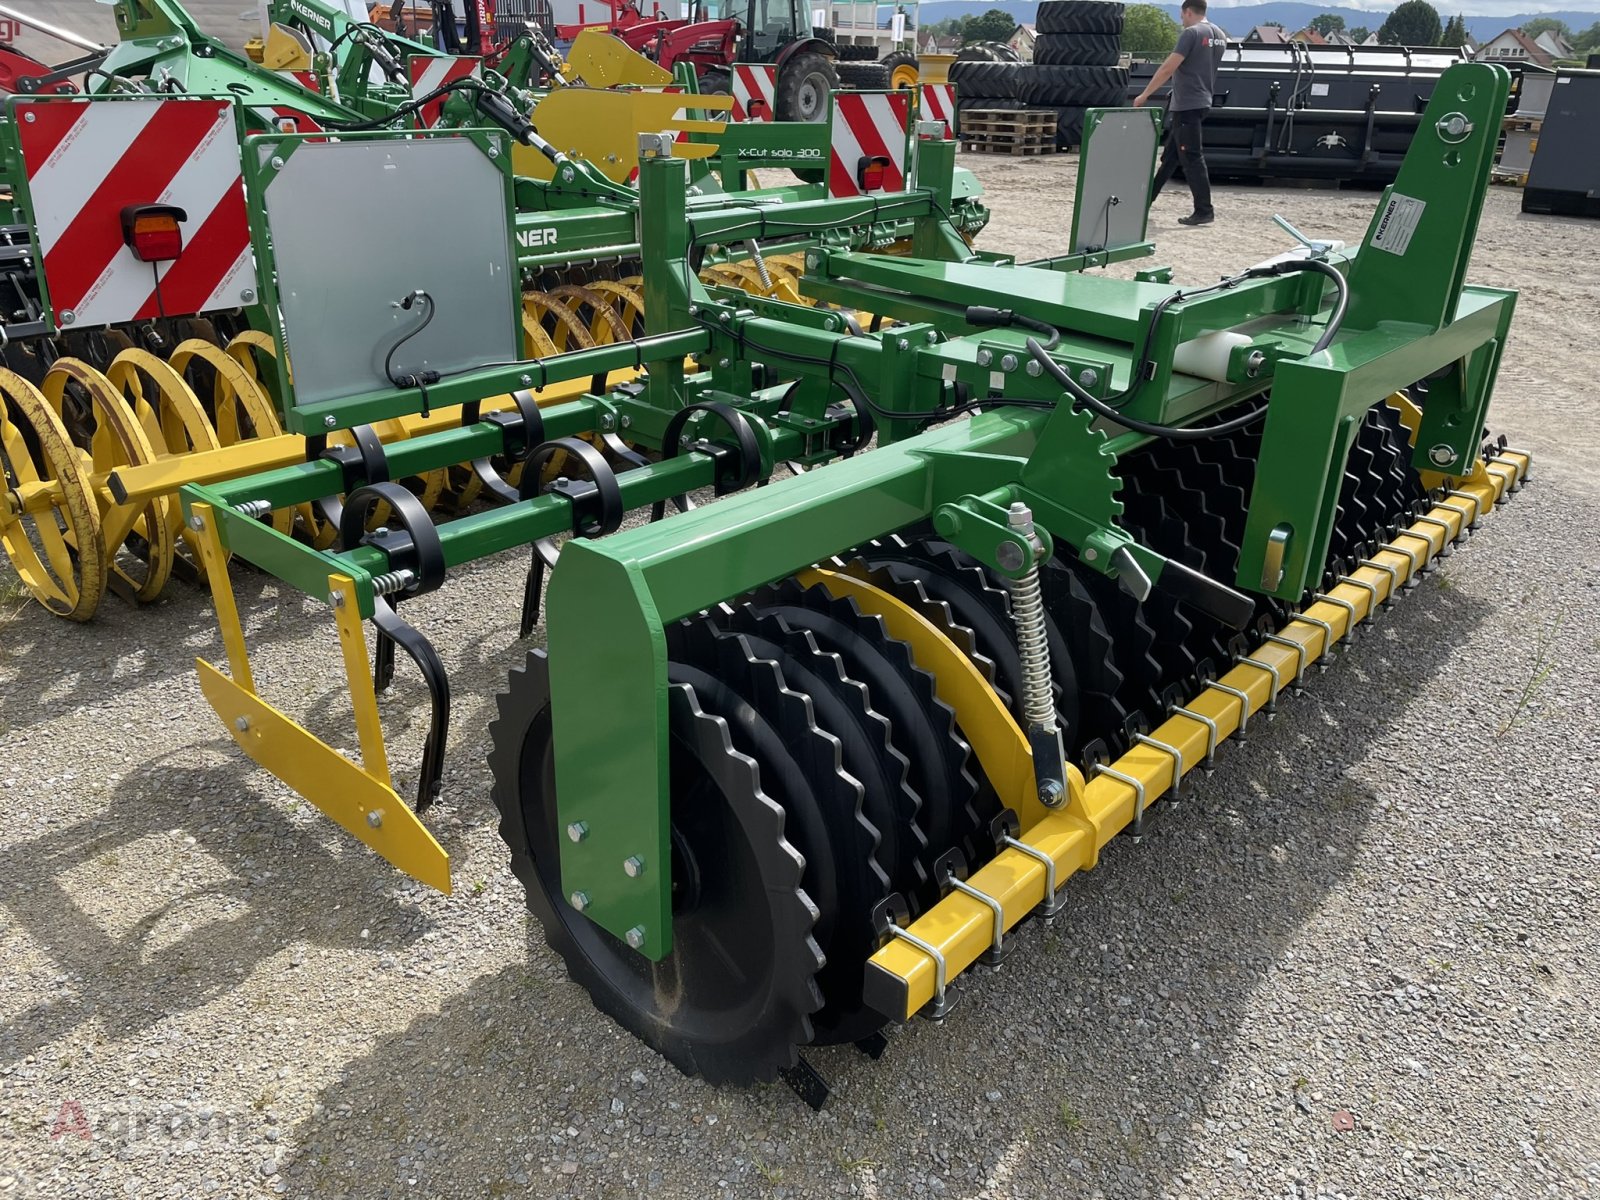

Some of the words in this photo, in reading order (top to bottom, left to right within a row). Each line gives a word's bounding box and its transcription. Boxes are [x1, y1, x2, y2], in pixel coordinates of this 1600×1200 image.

[296, 3, 331, 31] KERNER
[738, 148, 767, 157] X-Cut
[771, 148, 793, 157] solo
[796, 148, 821, 157] 300
[1380, 200, 1397, 235] KERNER
